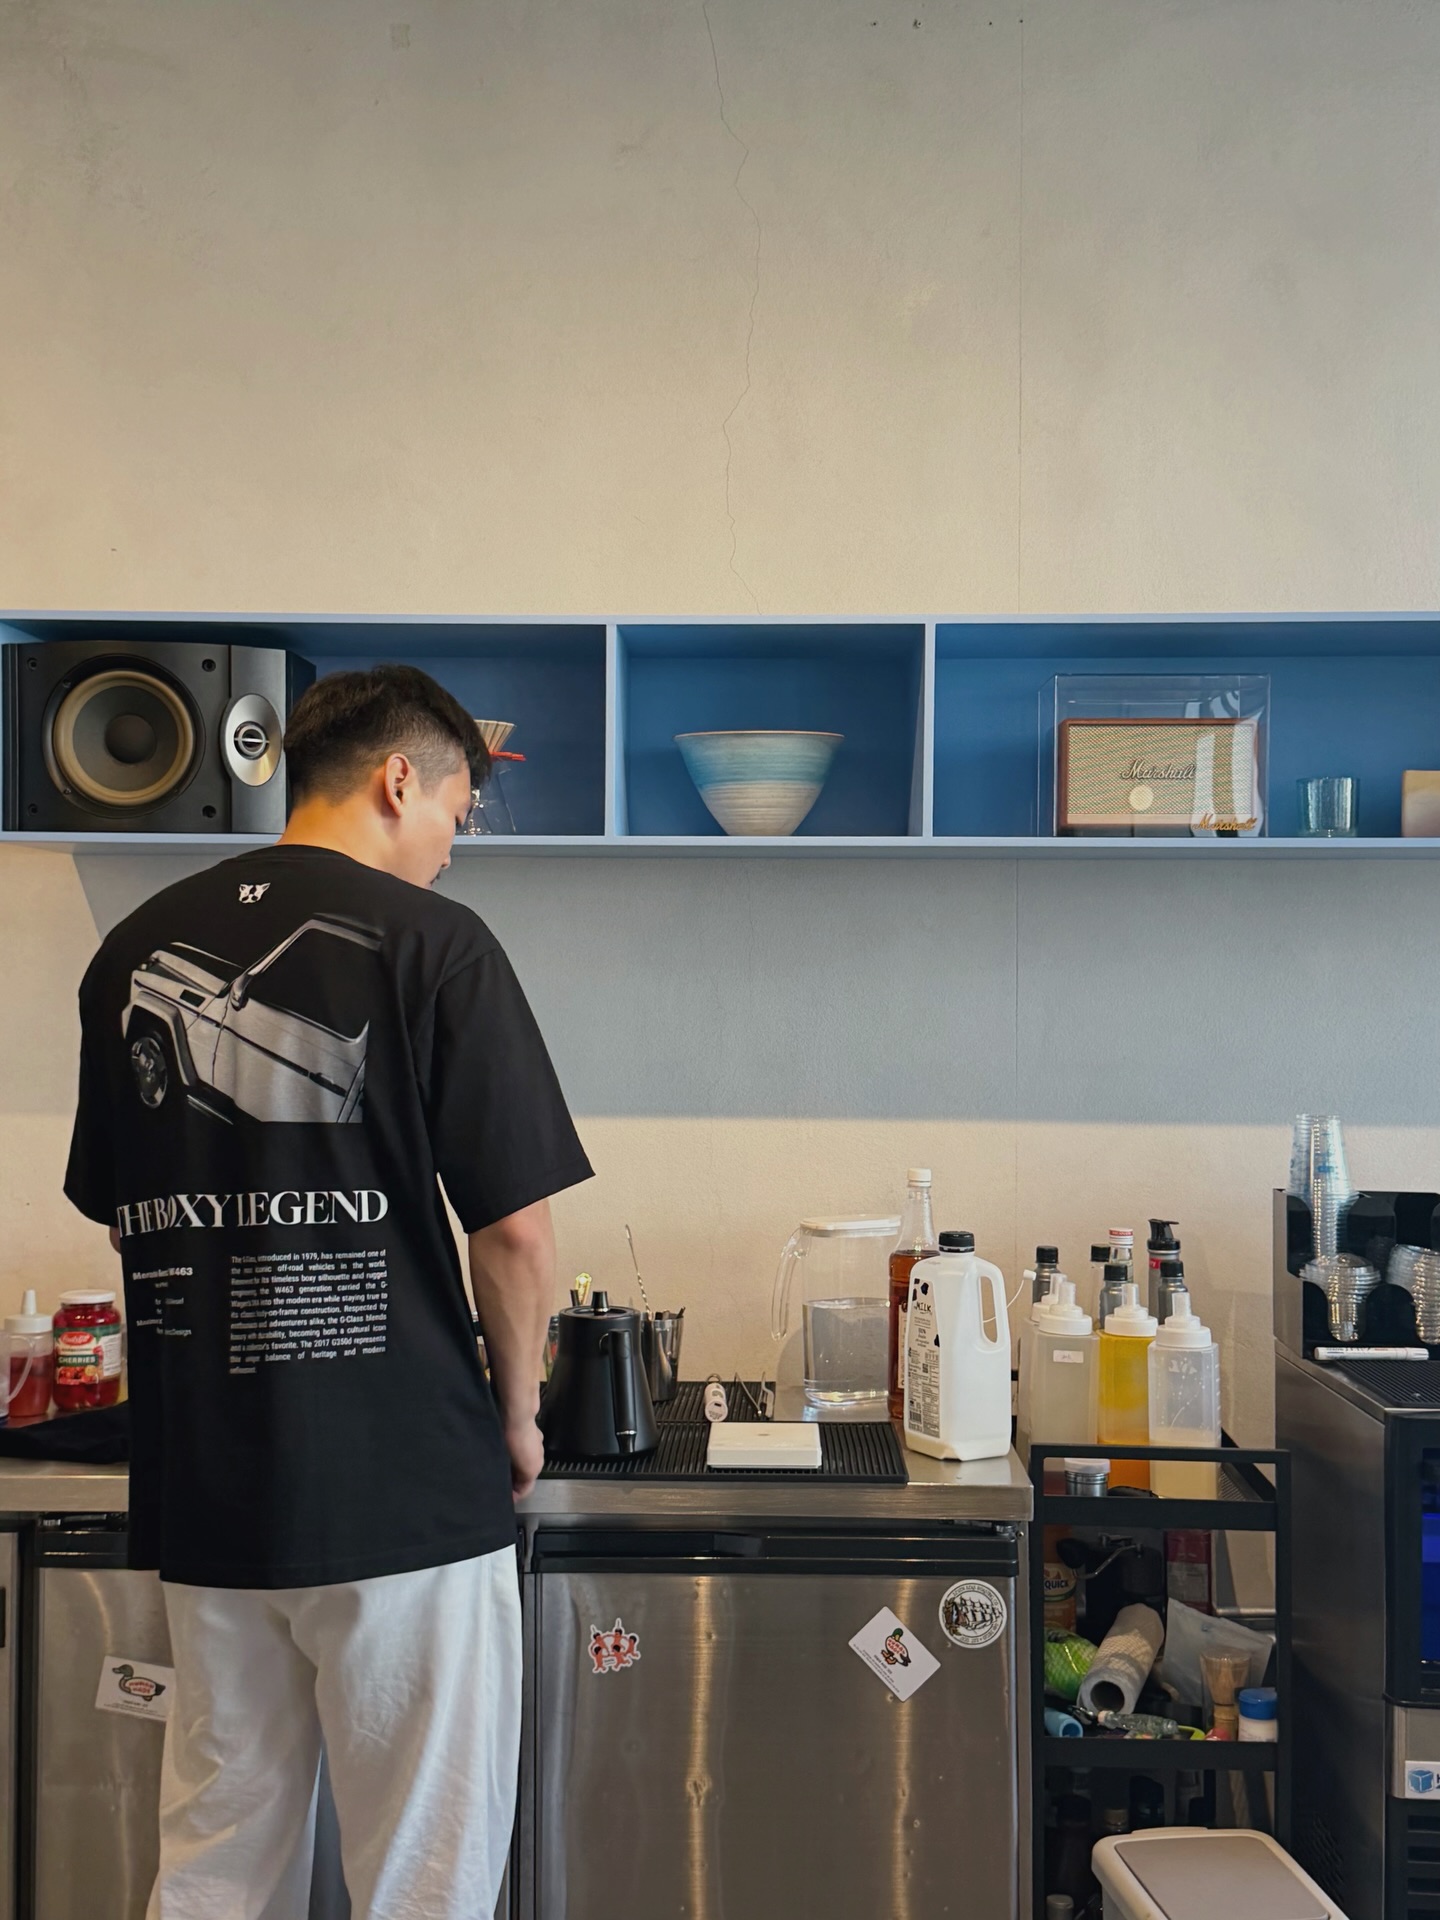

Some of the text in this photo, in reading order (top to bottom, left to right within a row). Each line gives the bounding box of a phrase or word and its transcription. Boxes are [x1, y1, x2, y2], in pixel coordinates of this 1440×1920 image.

[1121, 759, 1197, 780] Marshall
[1192, 813, 1258, 831] Marshall
[236, 1190, 388, 1227] LEGEND
[302, 1252, 319, 1260] 1979,
[335, 1250, 366, 1259] remained
[271, 1275, 299, 1283] timeless
[301, 1274, 316, 1283] boxy
[366, 1270, 387, 1280] rugged
[299, 1285, 332, 1294] generation
[337, 1283, 360, 1291] carried
[286, 1296, 310, 1304] modern
[342, 1294, 365, 1302] staying
[301, 1306, 341, 1314] construction.
[344, 1304, 377, 1313] Respected
[380, 1303, 388, 1311] by
[340, 1315, 364, 1323] G-Class
[289, 1329, 320, 1337] becoming
[347, 1324, 370, 1333] cultural
[314, 1339, 330, 1347] 2017
[354, 1336, 386, 1345] represents
[265, 1353, 291, 1361] balance
[297, 1351, 305, 1360] of
[312, 1351, 337, 1359] heritage
[344, 1348, 356, 1356] and
[362, 1346, 386, 1354] modern
